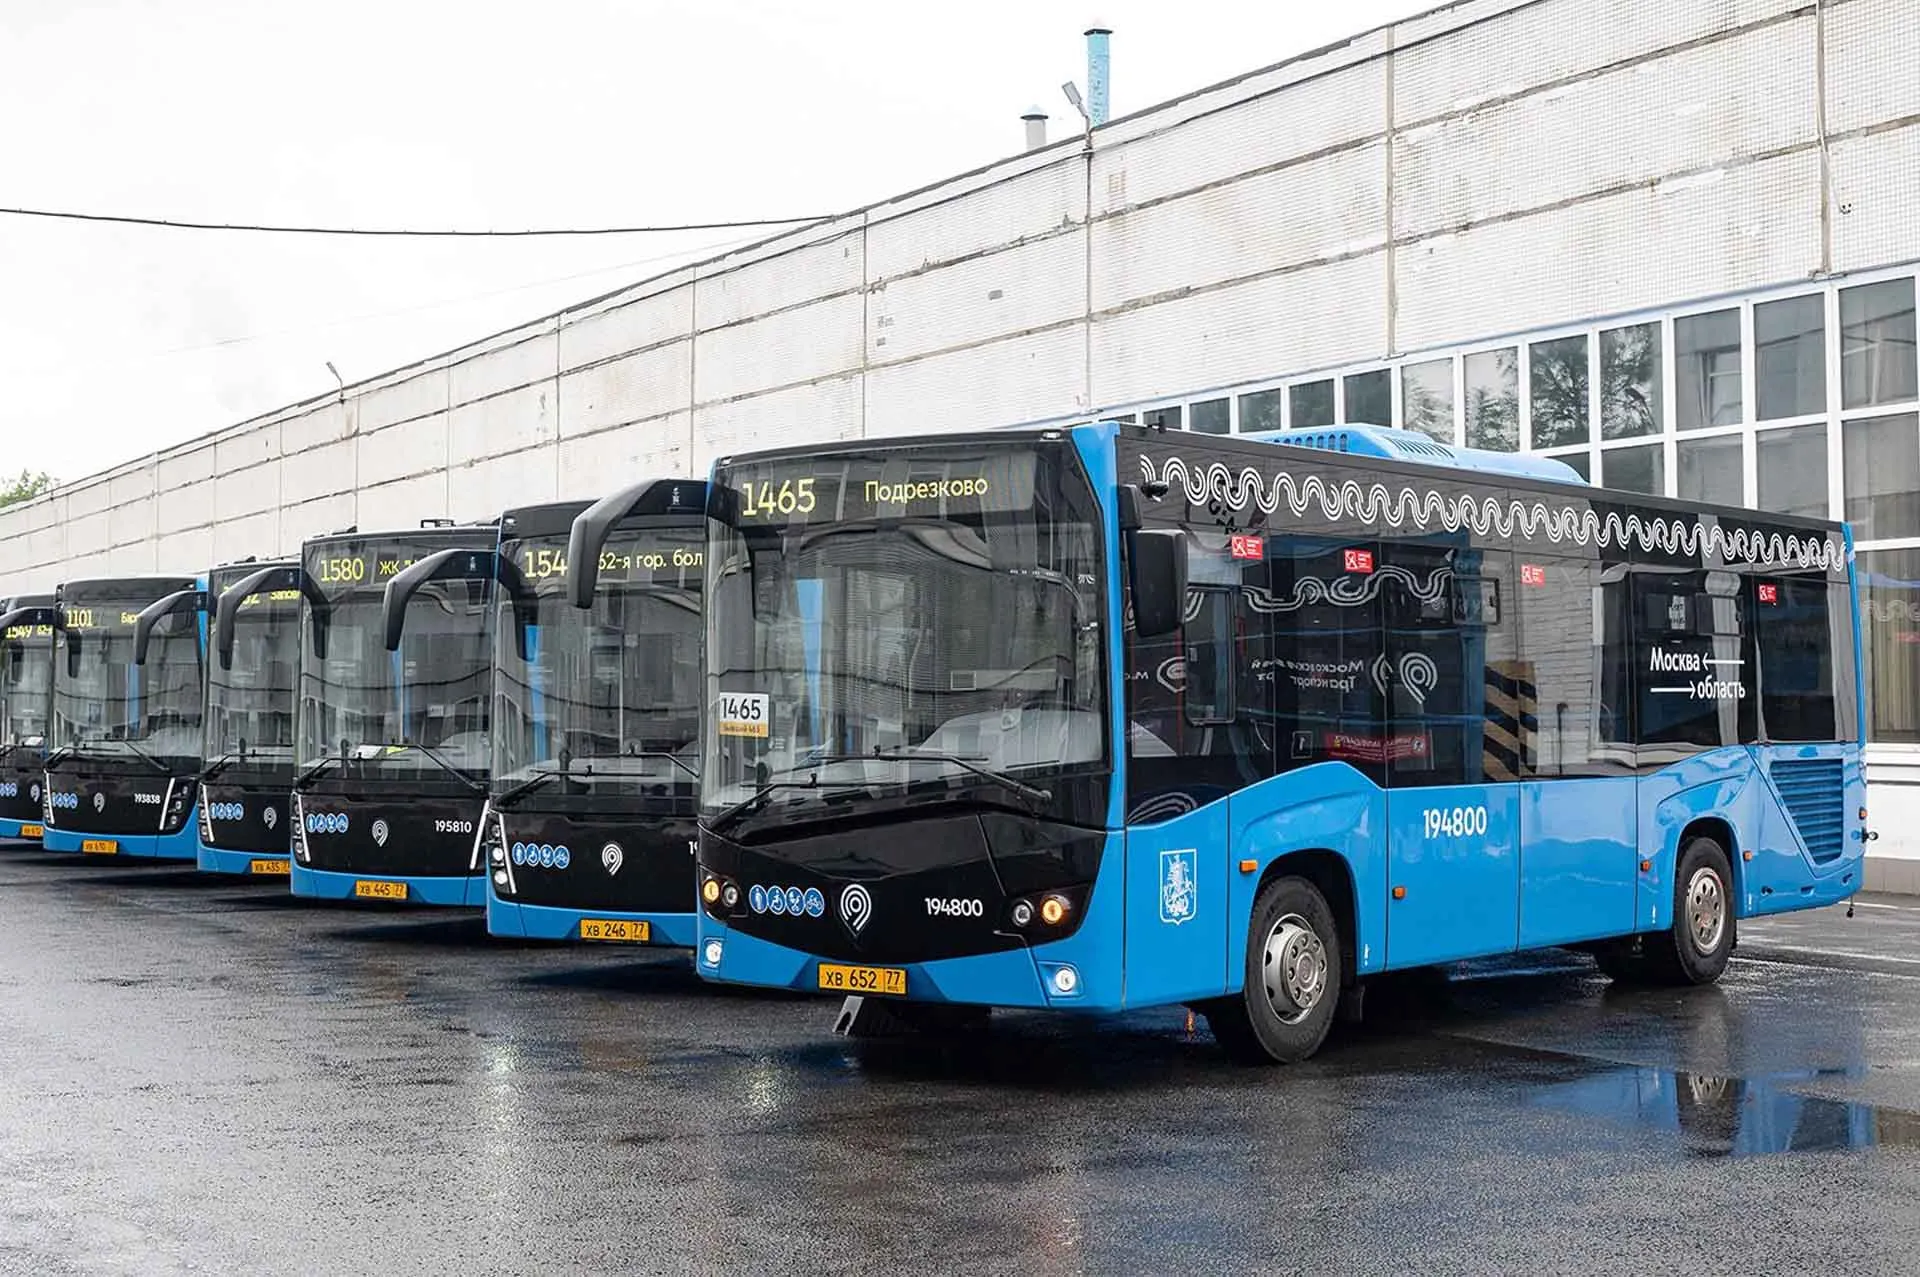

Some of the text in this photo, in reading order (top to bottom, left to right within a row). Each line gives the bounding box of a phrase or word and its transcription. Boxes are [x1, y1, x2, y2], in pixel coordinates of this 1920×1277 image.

[742, 477, 988, 516] 1465 Подрезково
[320, 557, 400, 582] 1580 ЖК
[636, 552, 668, 571] гор.
[672, 548, 704, 567] бол
[66, 609, 93, 628] 1101
[1650, 647, 1700, 672] Москва
[1697, 674, 1746, 700] область
[721, 697, 761, 720] 1465
[434, 819, 473, 834] 195810
[1423, 806, 1488, 839] 194800
[373, 882, 391, 896] 445
[924, 897, 983, 917] 194800
[604, 923, 626, 938] 246
[633, 922, 644, 934] 77
[849, 969, 877, 989] 652
[886, 970, 900, 985] 77
